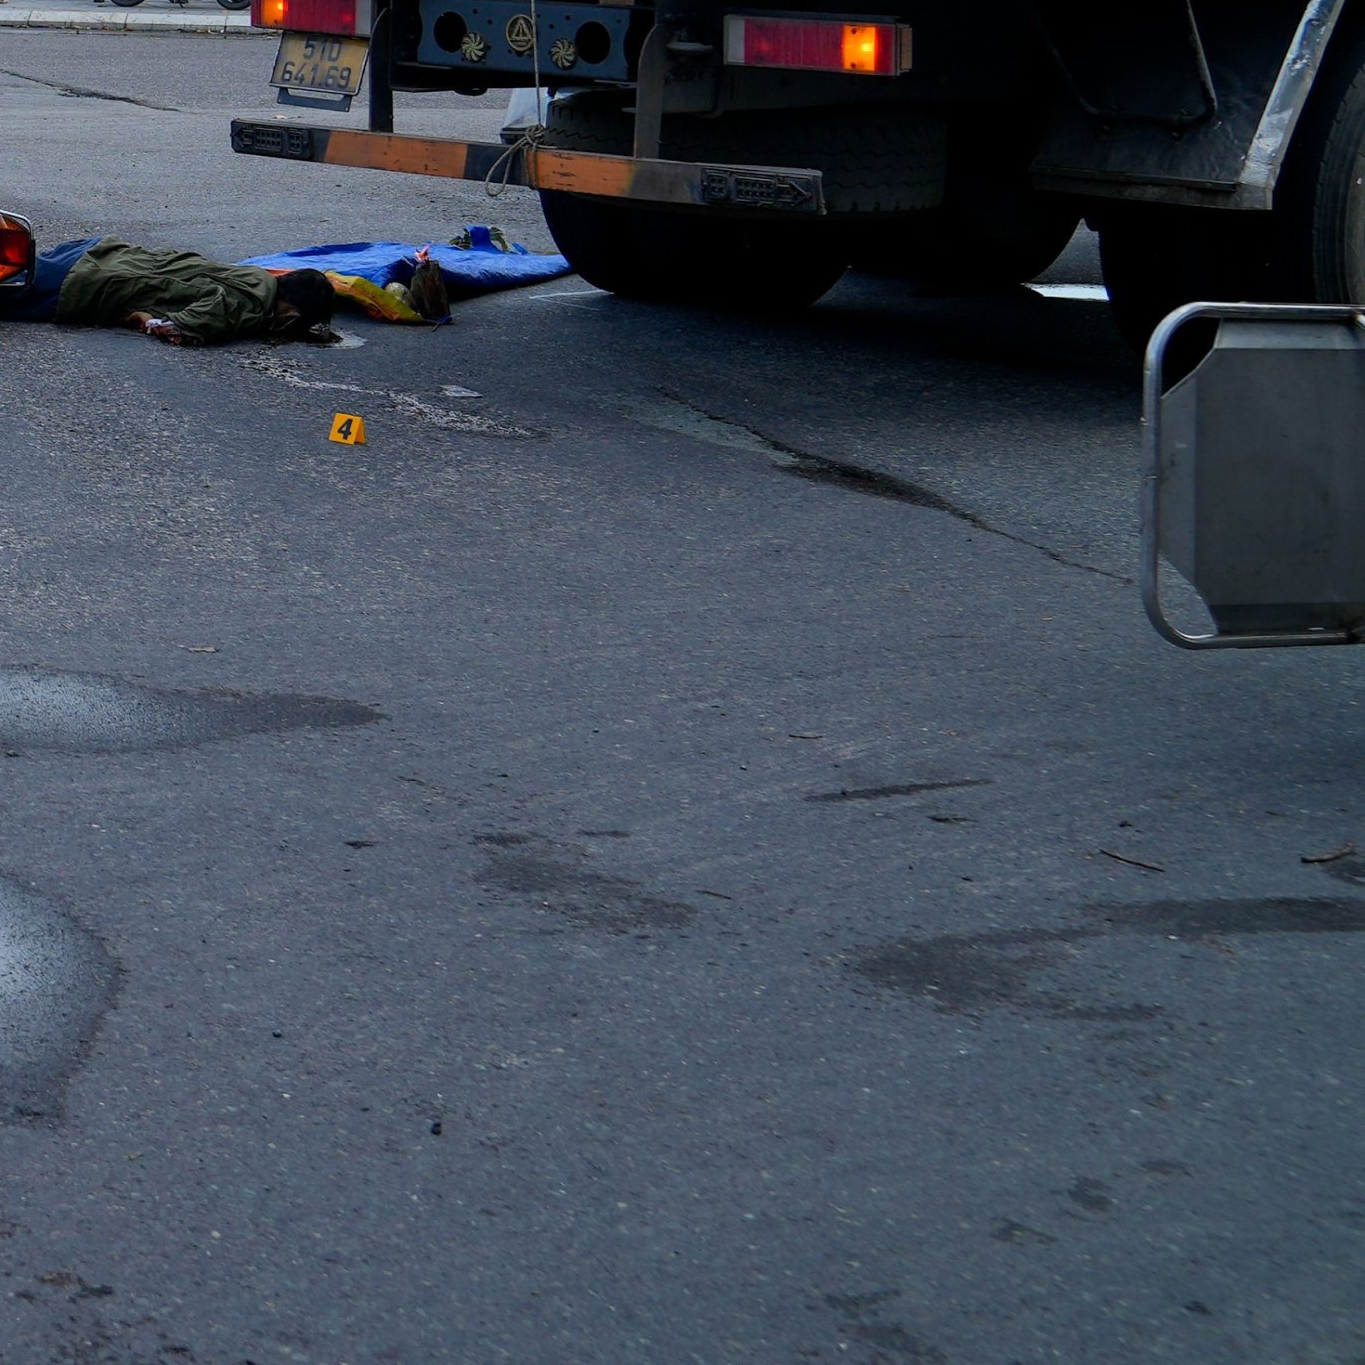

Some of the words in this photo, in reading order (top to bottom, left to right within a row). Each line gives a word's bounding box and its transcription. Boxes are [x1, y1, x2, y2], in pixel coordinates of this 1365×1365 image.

[302, 35, 343, 62] 51D
[281, 61, 352, 89] 641.69
[337, 418, 354, 440] 4
